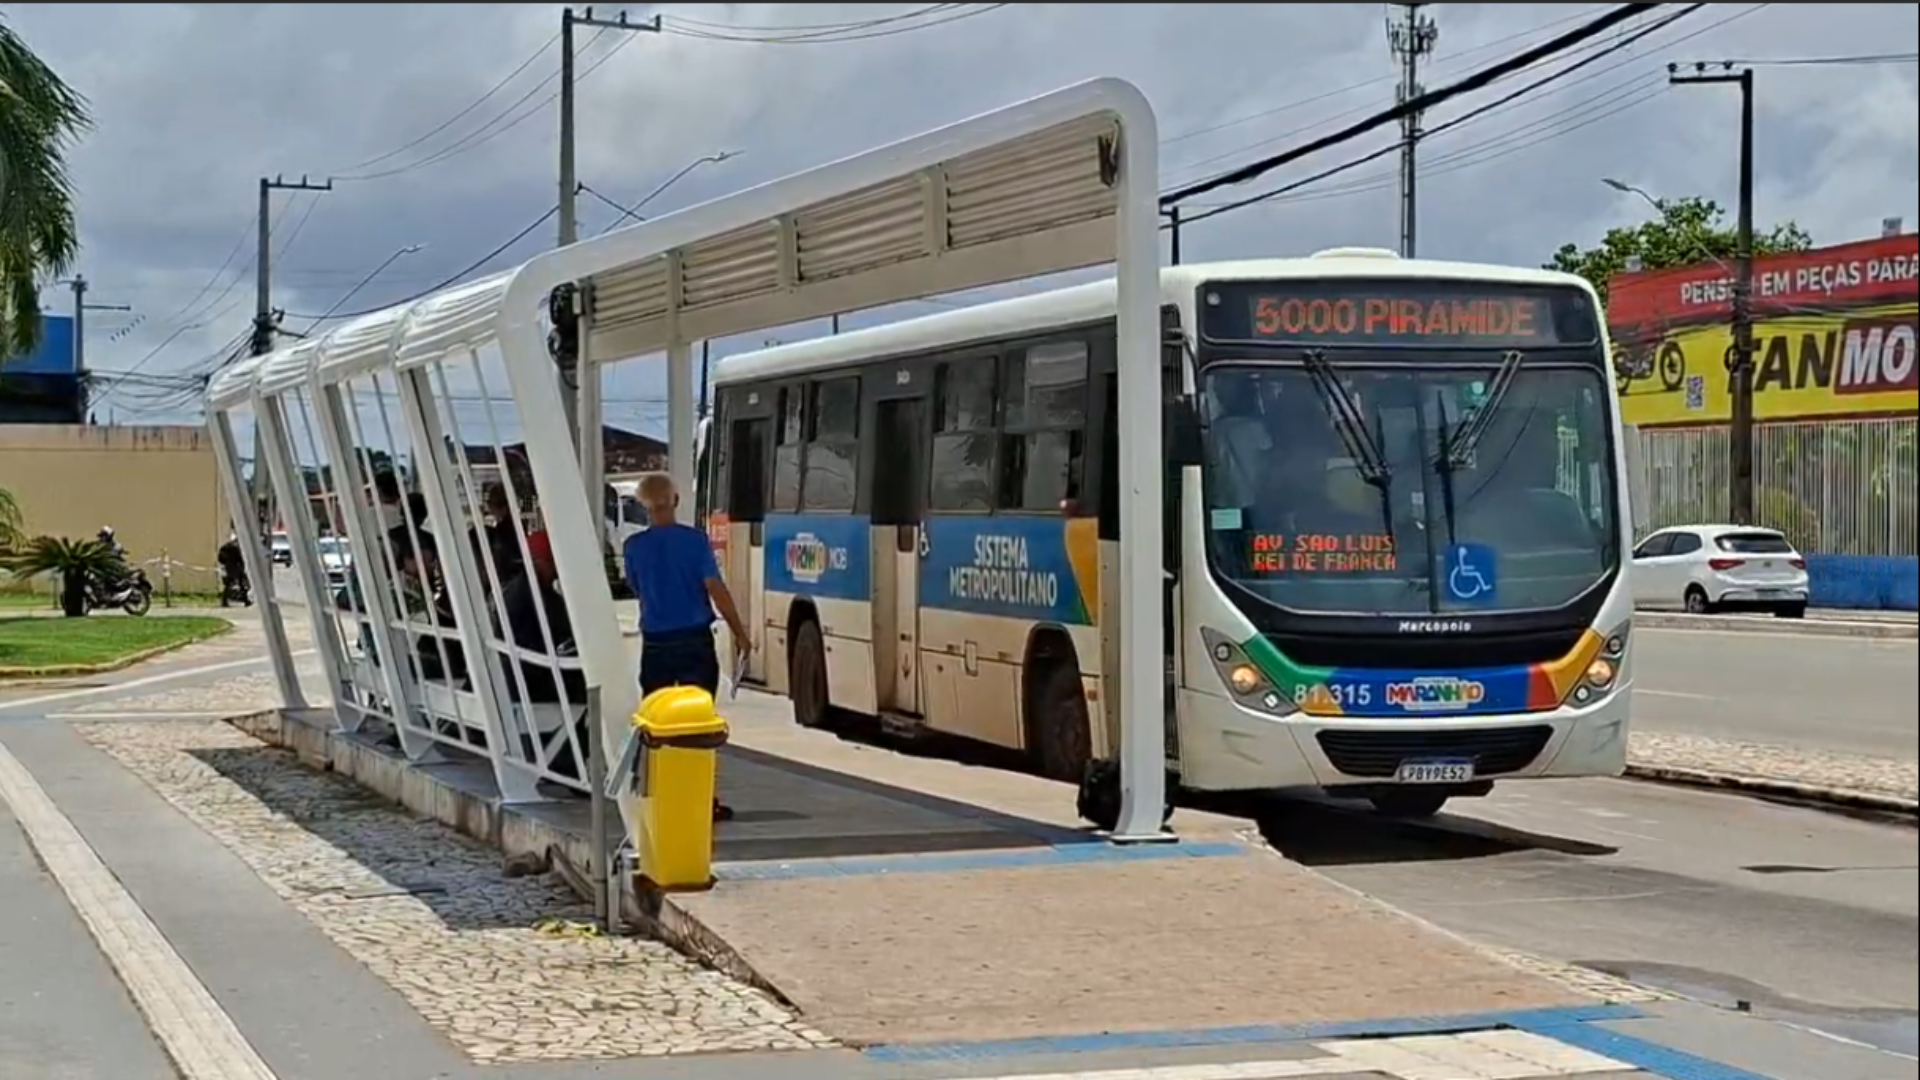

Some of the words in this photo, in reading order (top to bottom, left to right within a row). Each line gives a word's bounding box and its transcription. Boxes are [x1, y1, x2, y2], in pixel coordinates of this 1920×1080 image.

[1761, 270, 1790, 296] EM
[1796, 262, 1859, 297] PEÇAS
[1867, 254, 1918, 283] PARA
[1255, 299, 1356, 334] 5000
[1364, 299, 1535, 336] PIRAMIDE
[974, 534, 1028, 568] SISTEMA
[1295, 535, 1338, 551] SAO
[1346, 535, 1393, 551] LUIS
[1253, 553, 1285, 570] REI
[1293, 553, 1317, 570] DE
[950, 566, 1058, 607] METROPOLITANO
[1294, 684, 1371, 706] 81.315
